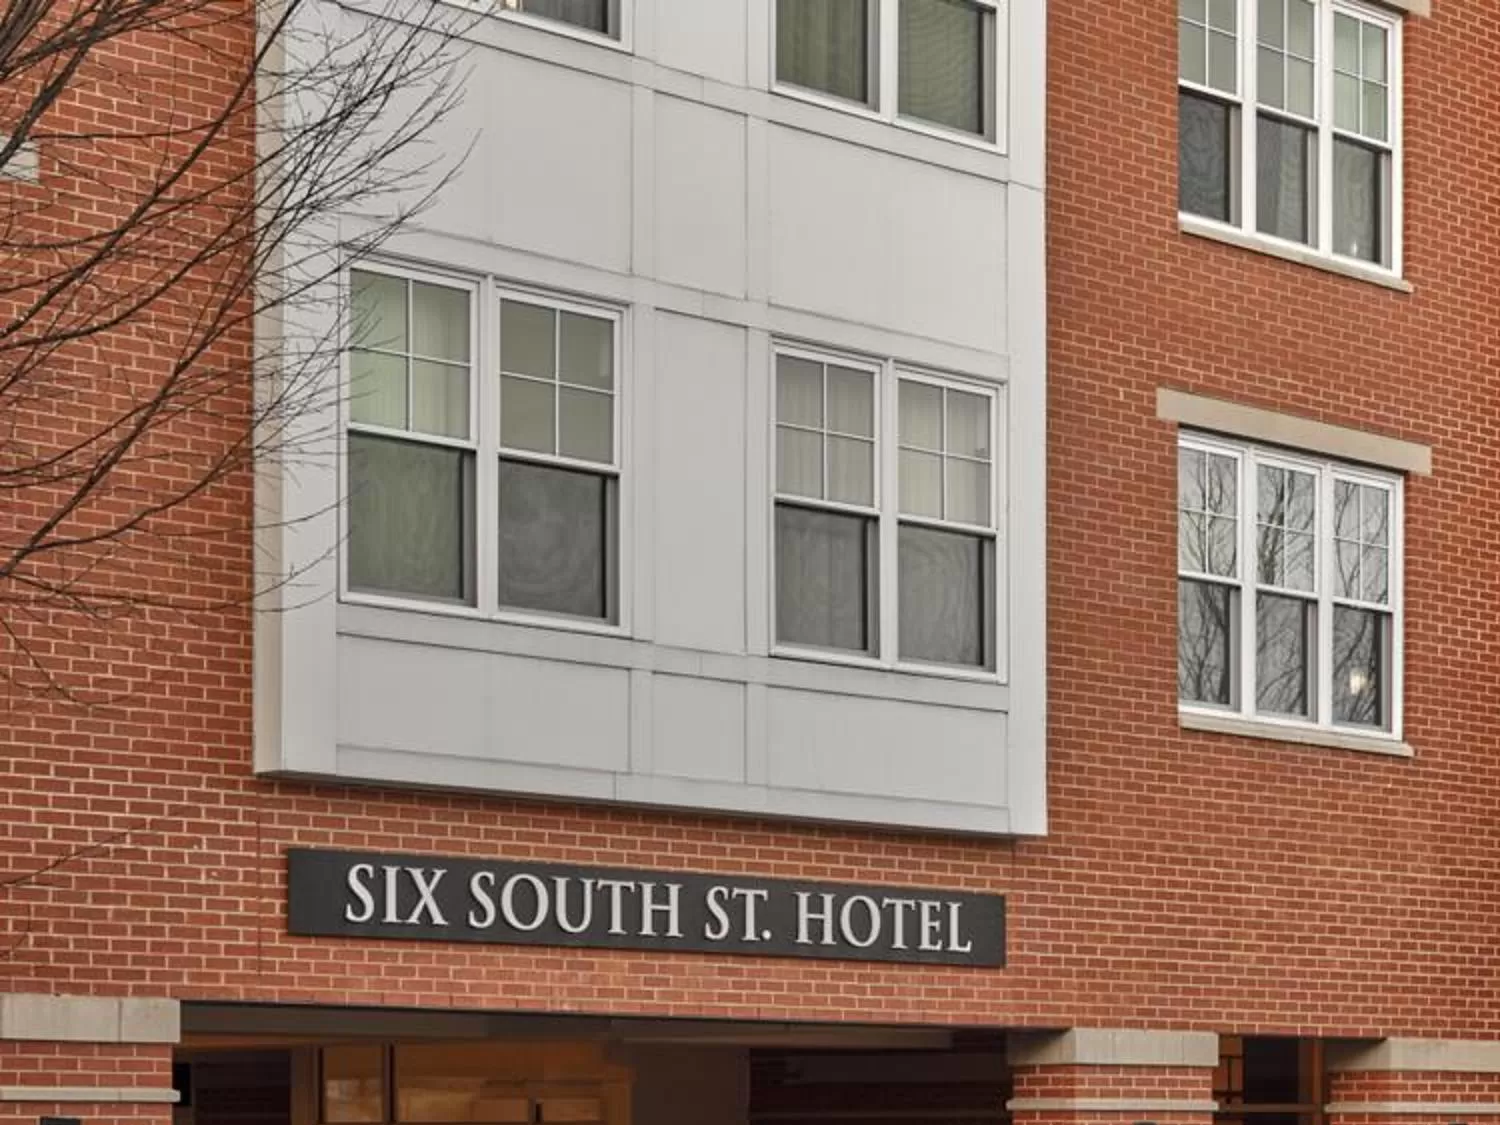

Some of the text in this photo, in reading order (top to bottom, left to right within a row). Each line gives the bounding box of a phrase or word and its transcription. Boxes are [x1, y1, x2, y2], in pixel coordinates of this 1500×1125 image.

[344, 862, 972, 954] SIX SOUTH ST. HOTEL
